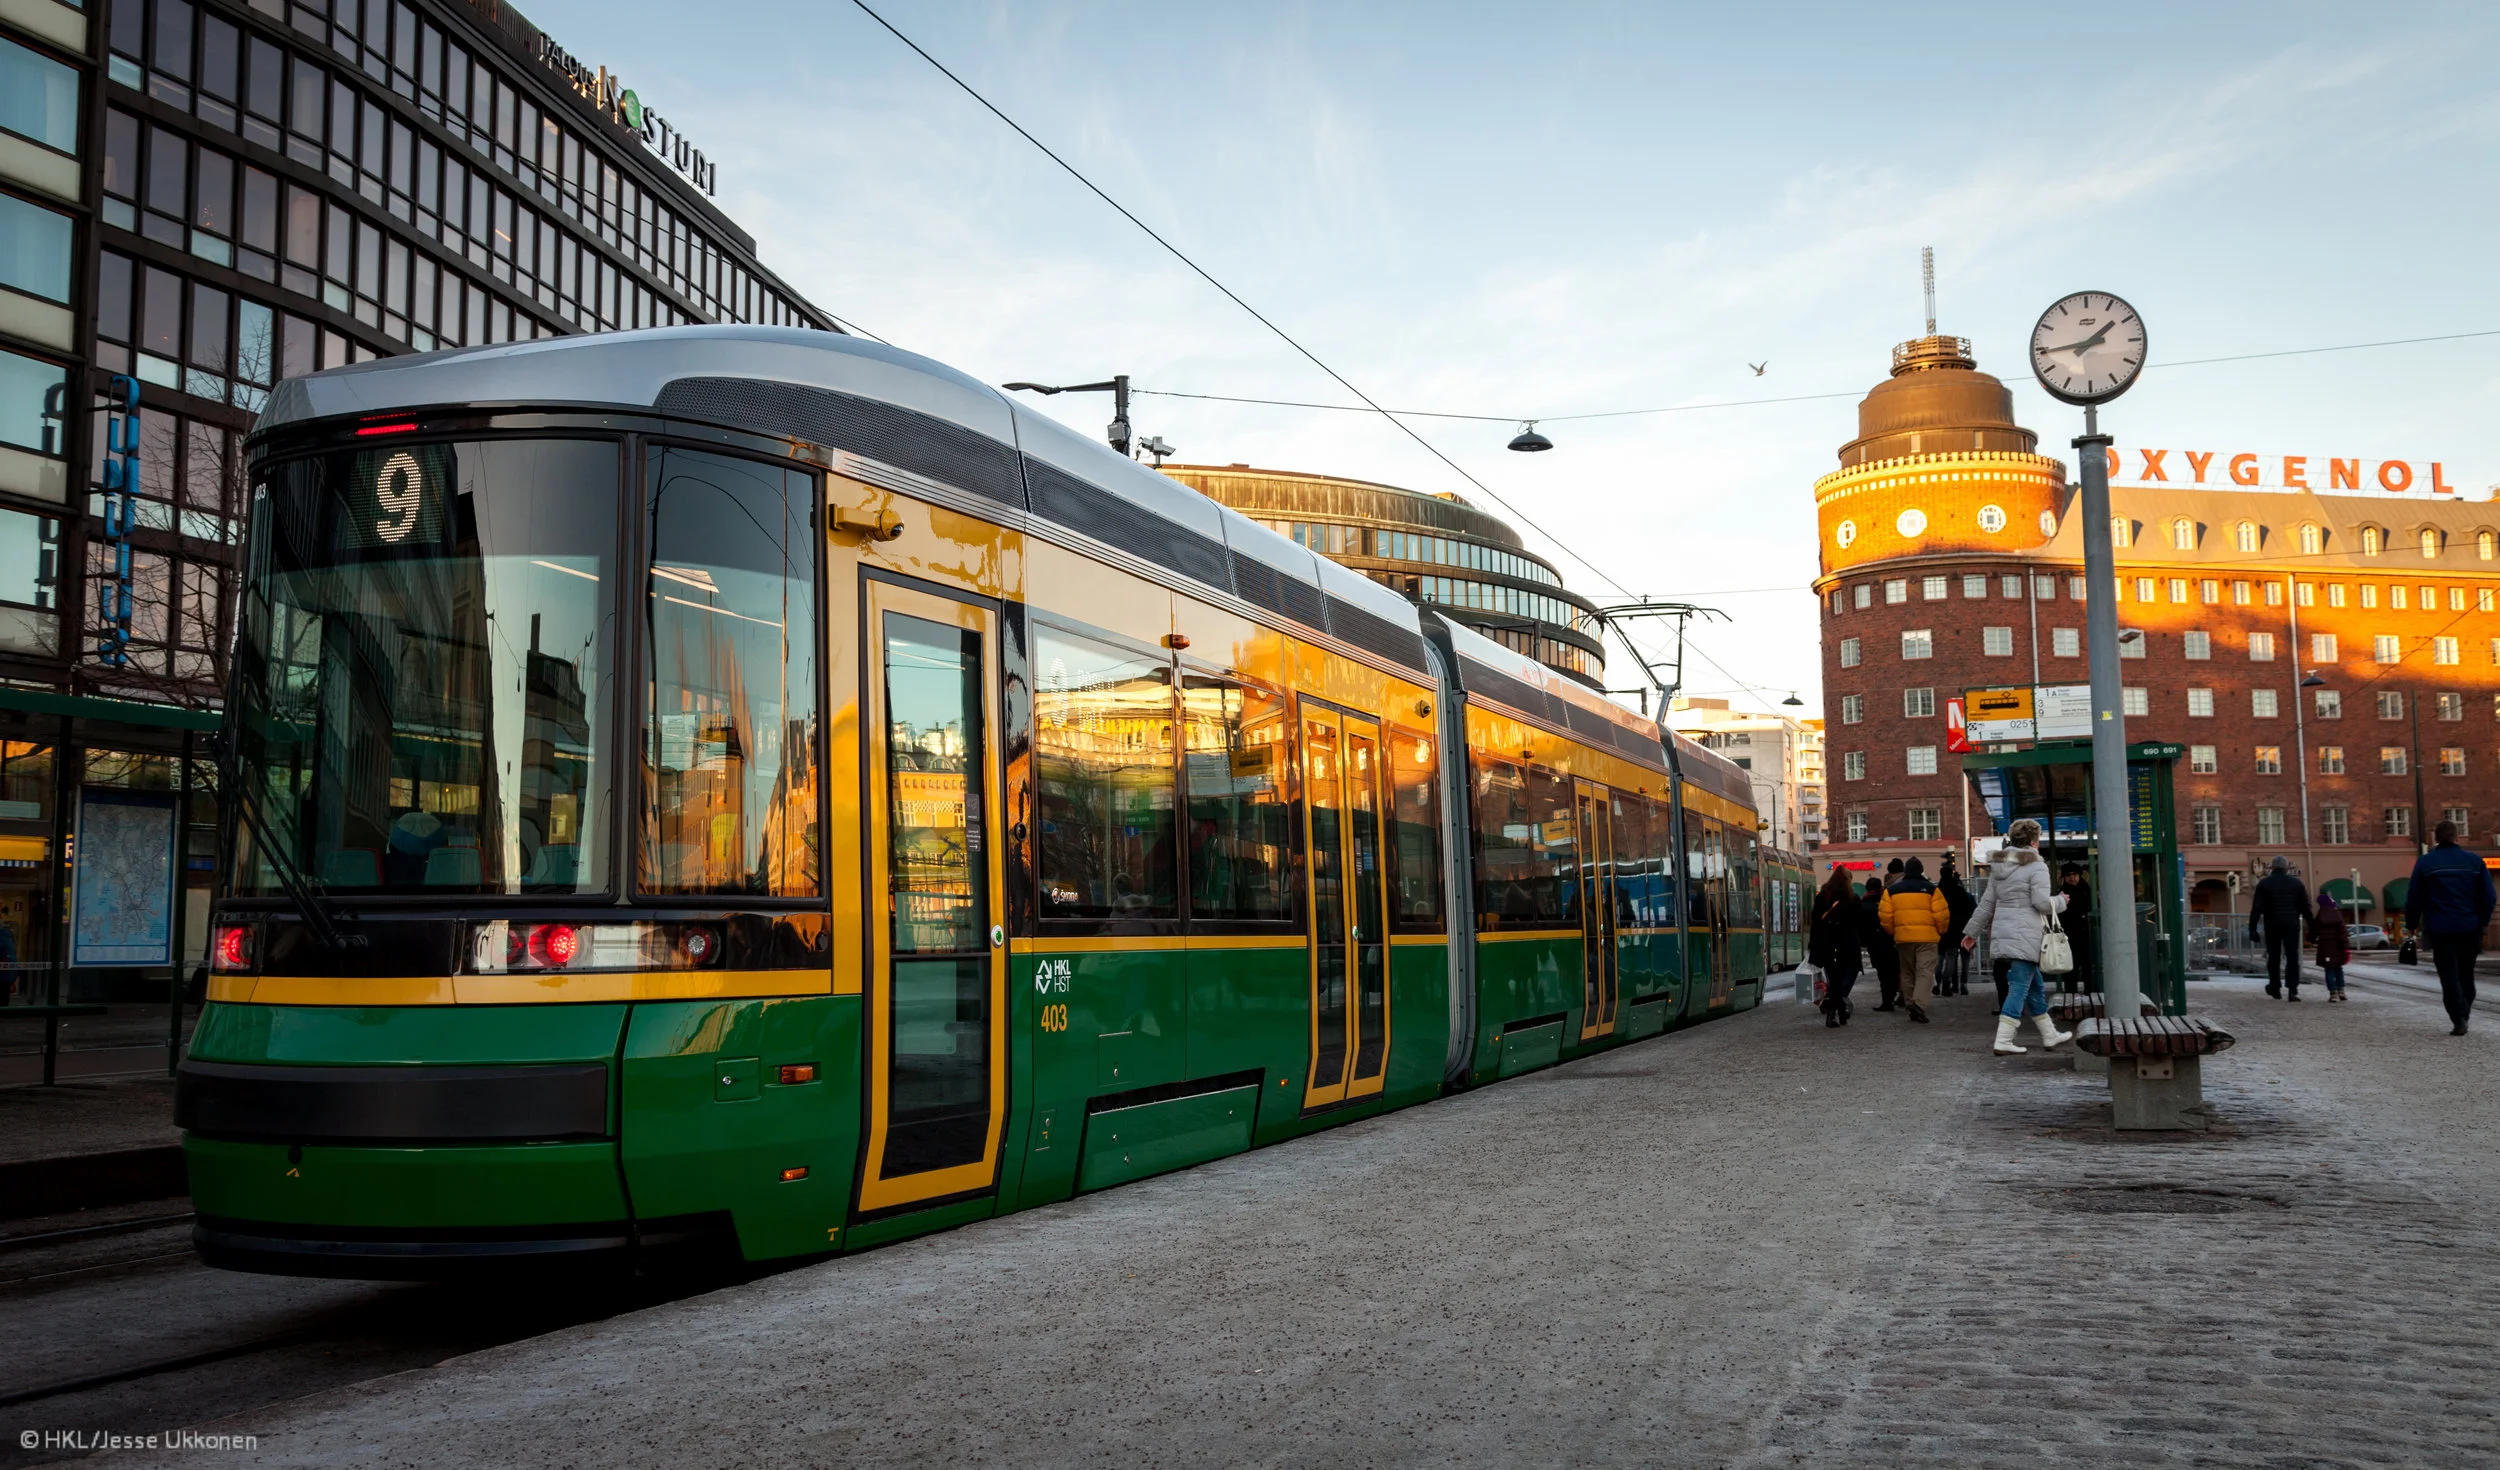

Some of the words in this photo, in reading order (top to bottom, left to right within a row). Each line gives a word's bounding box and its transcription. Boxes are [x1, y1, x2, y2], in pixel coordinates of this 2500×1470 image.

[377, 453, 422, 543] 9
[2163, 746, 2177, 754] 691
[1054, 960, 1071, 976] HKL
[1054, 976, 1071, 992] HST
[1041, 1004, 1067, 1033] 403
